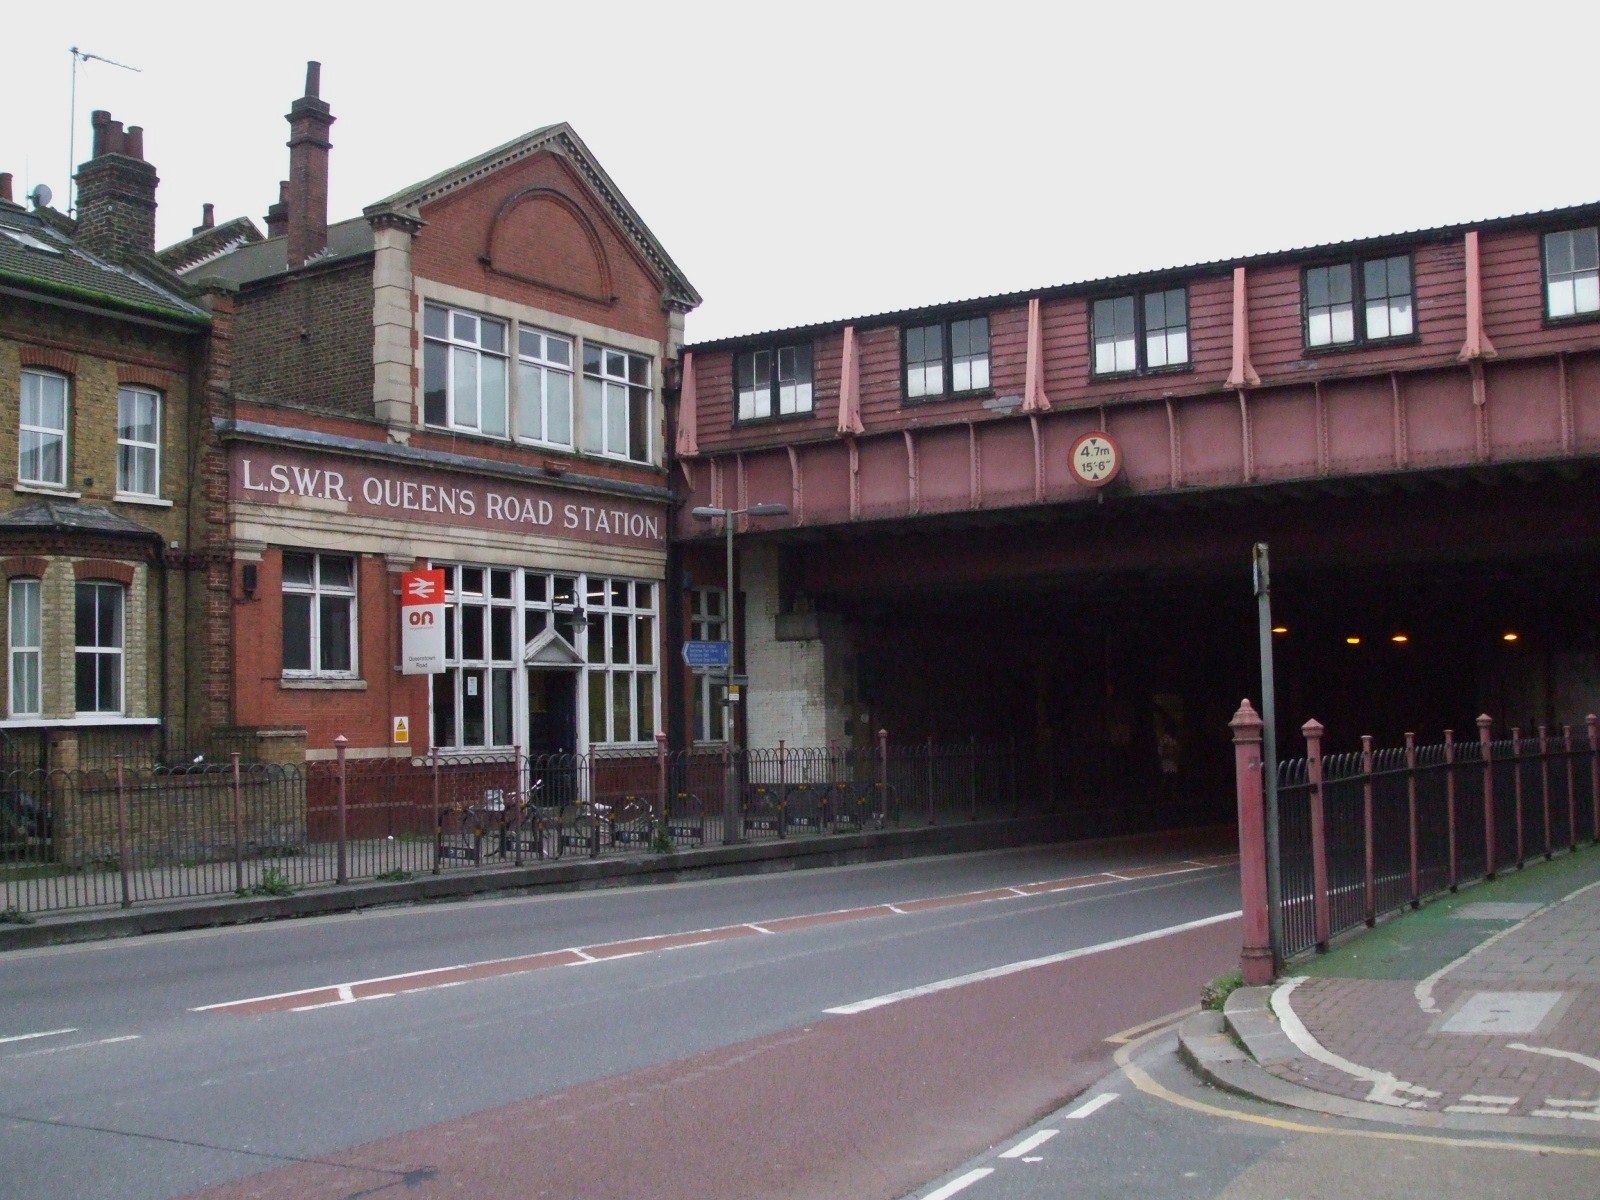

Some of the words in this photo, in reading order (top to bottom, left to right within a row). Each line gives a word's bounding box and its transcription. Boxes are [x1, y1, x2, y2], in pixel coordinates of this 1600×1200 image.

[1080, 445, 1110, 457] 4.7m
[242, 459, 353, 502] L.S.W.R.
[362, 477, 476, 516] QUEEN'S
[486, 492, 553, 526] ROAD
[563, 504, 664, 540] STATION.
